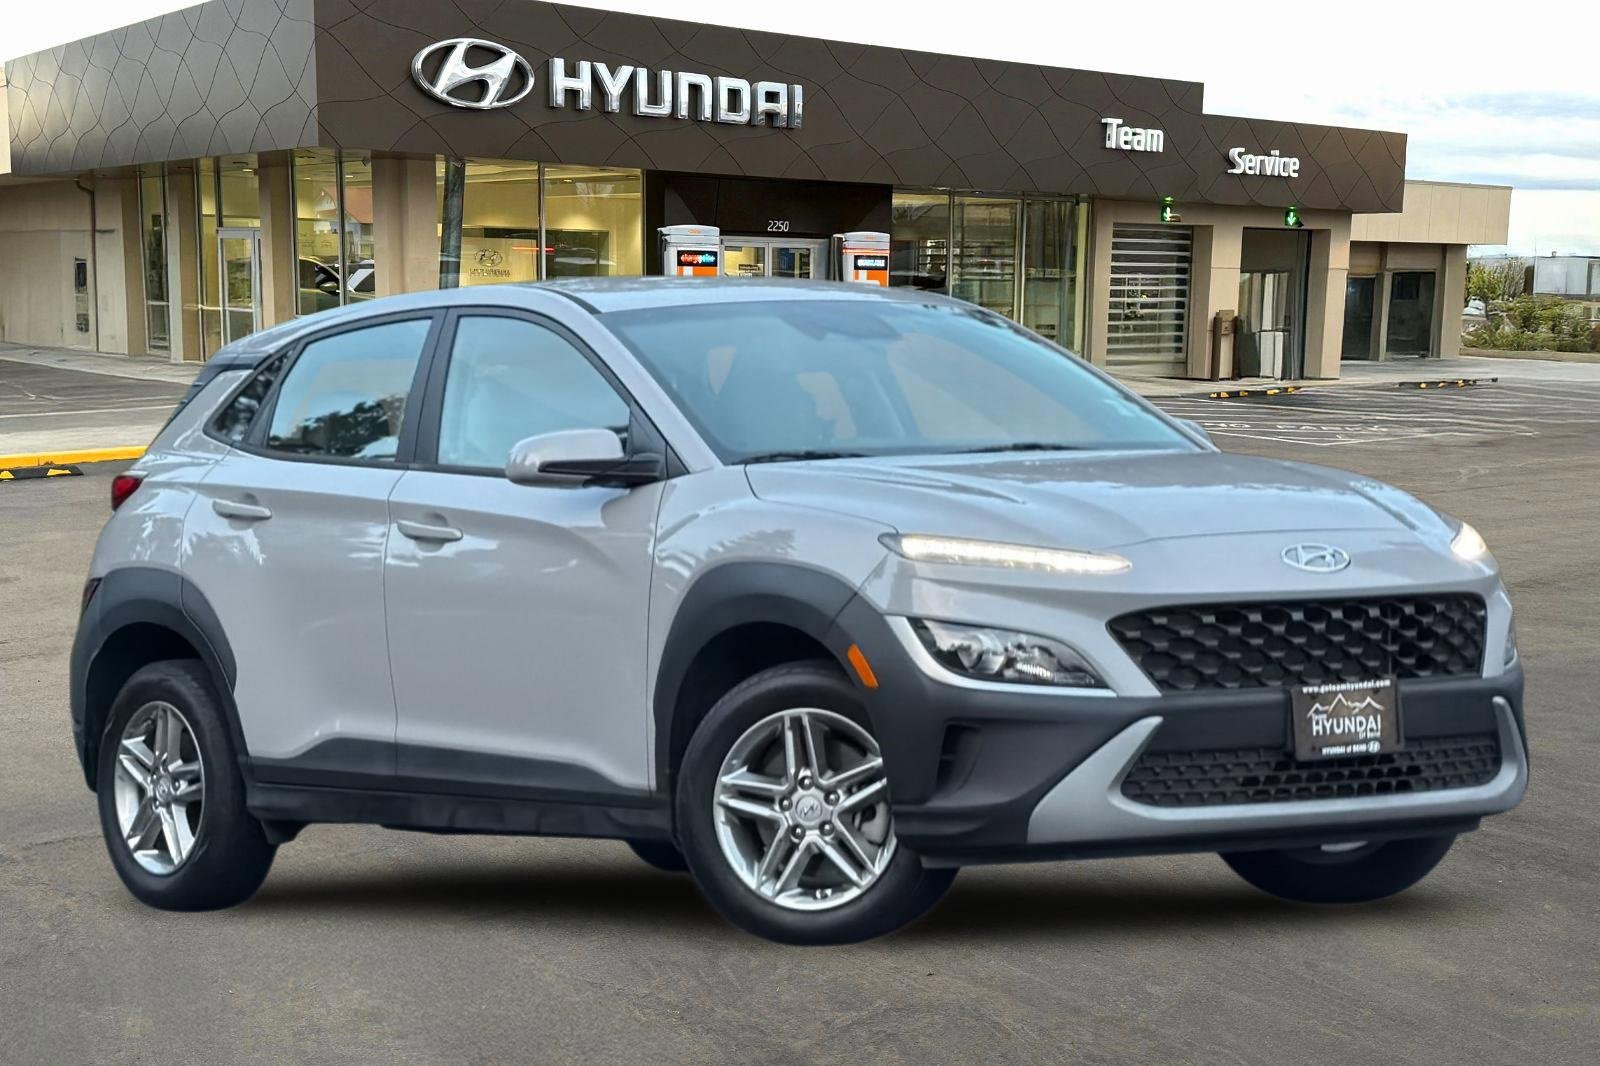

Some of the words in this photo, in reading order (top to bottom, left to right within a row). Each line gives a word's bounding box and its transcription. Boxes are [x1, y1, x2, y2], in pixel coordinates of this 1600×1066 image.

[549, 57, 804, 129] HYUNDAI
[1101, 117, 1164, 153] Team
[1227, 147, 1300, 178] Service
[767, 220, 790, 232] 2250
[1312, 714, 1381, 737] HYUNDAI
